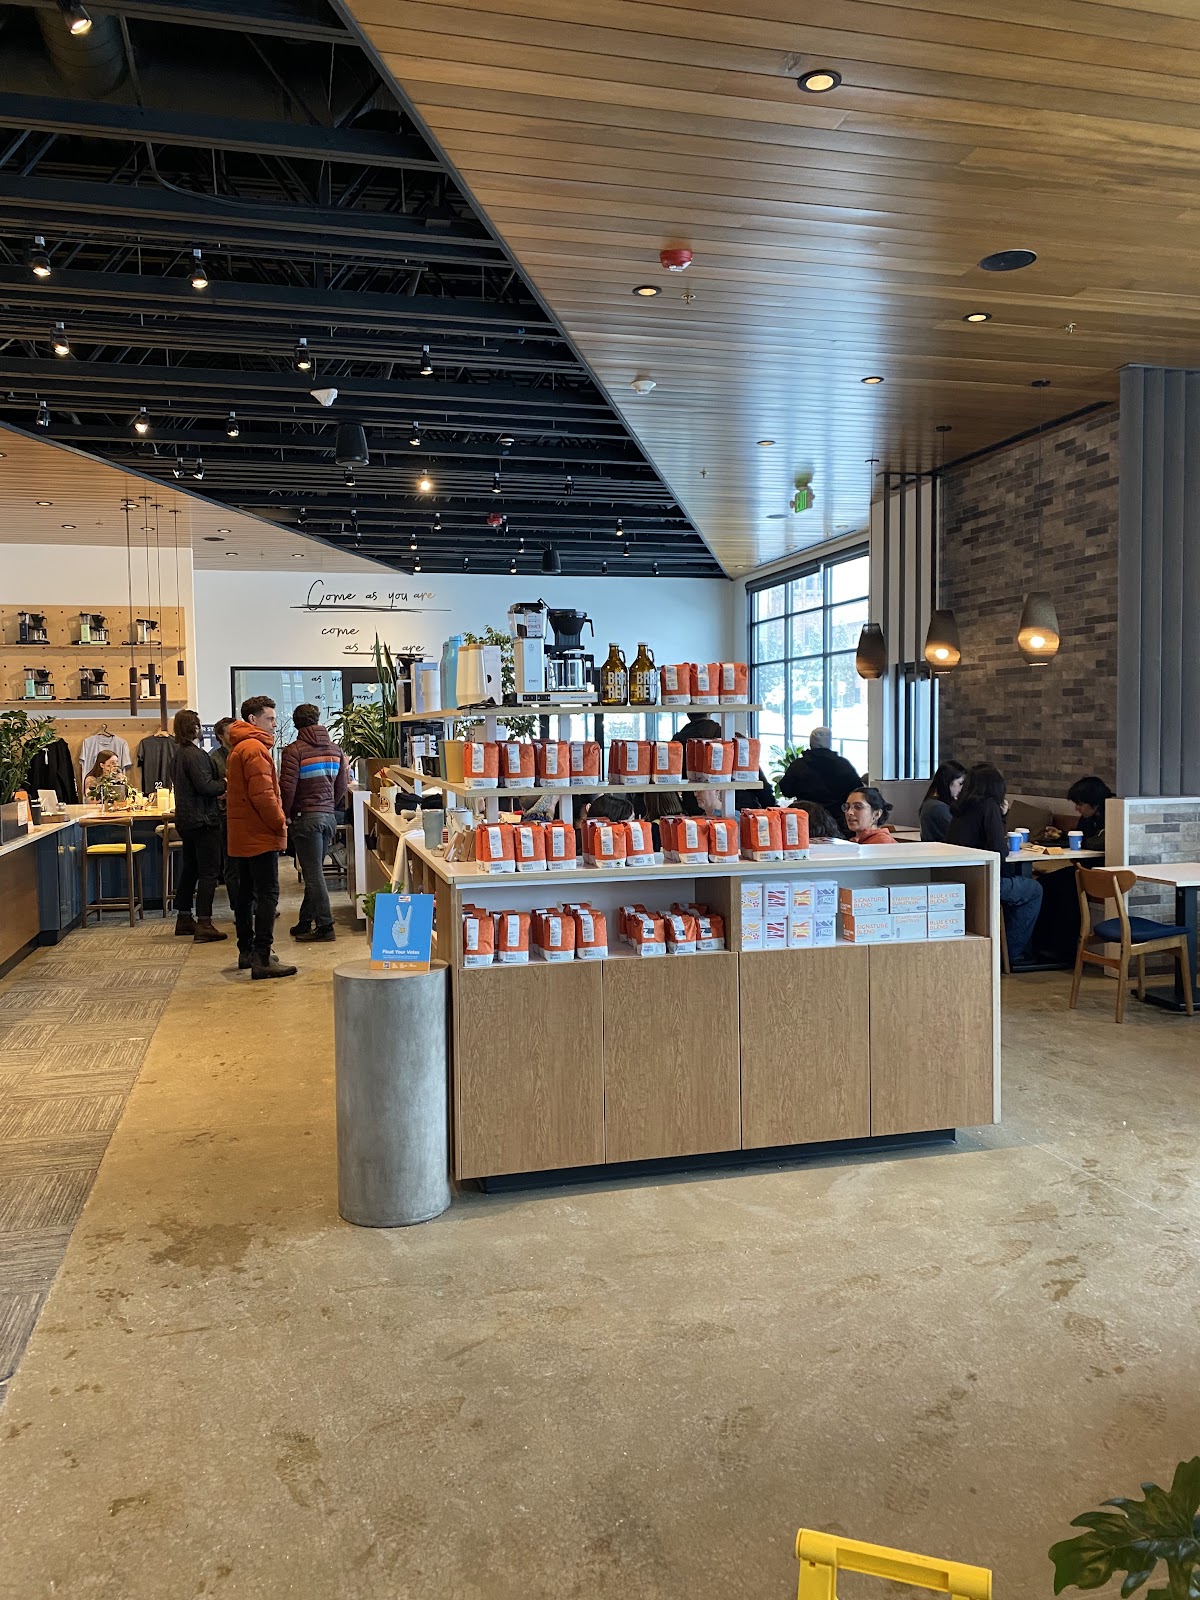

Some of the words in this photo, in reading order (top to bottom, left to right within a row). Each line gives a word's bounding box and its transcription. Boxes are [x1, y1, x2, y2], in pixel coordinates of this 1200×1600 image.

[307, 579, 356, 611] Come
[365, 592, 378, 600] as
[388, 591, 408, 609] you
[413, 592, 436, 601] are
[321, 627, 360, 637] come
[345, 643, 358, 651] as
[401, 645, 425, 654] are
